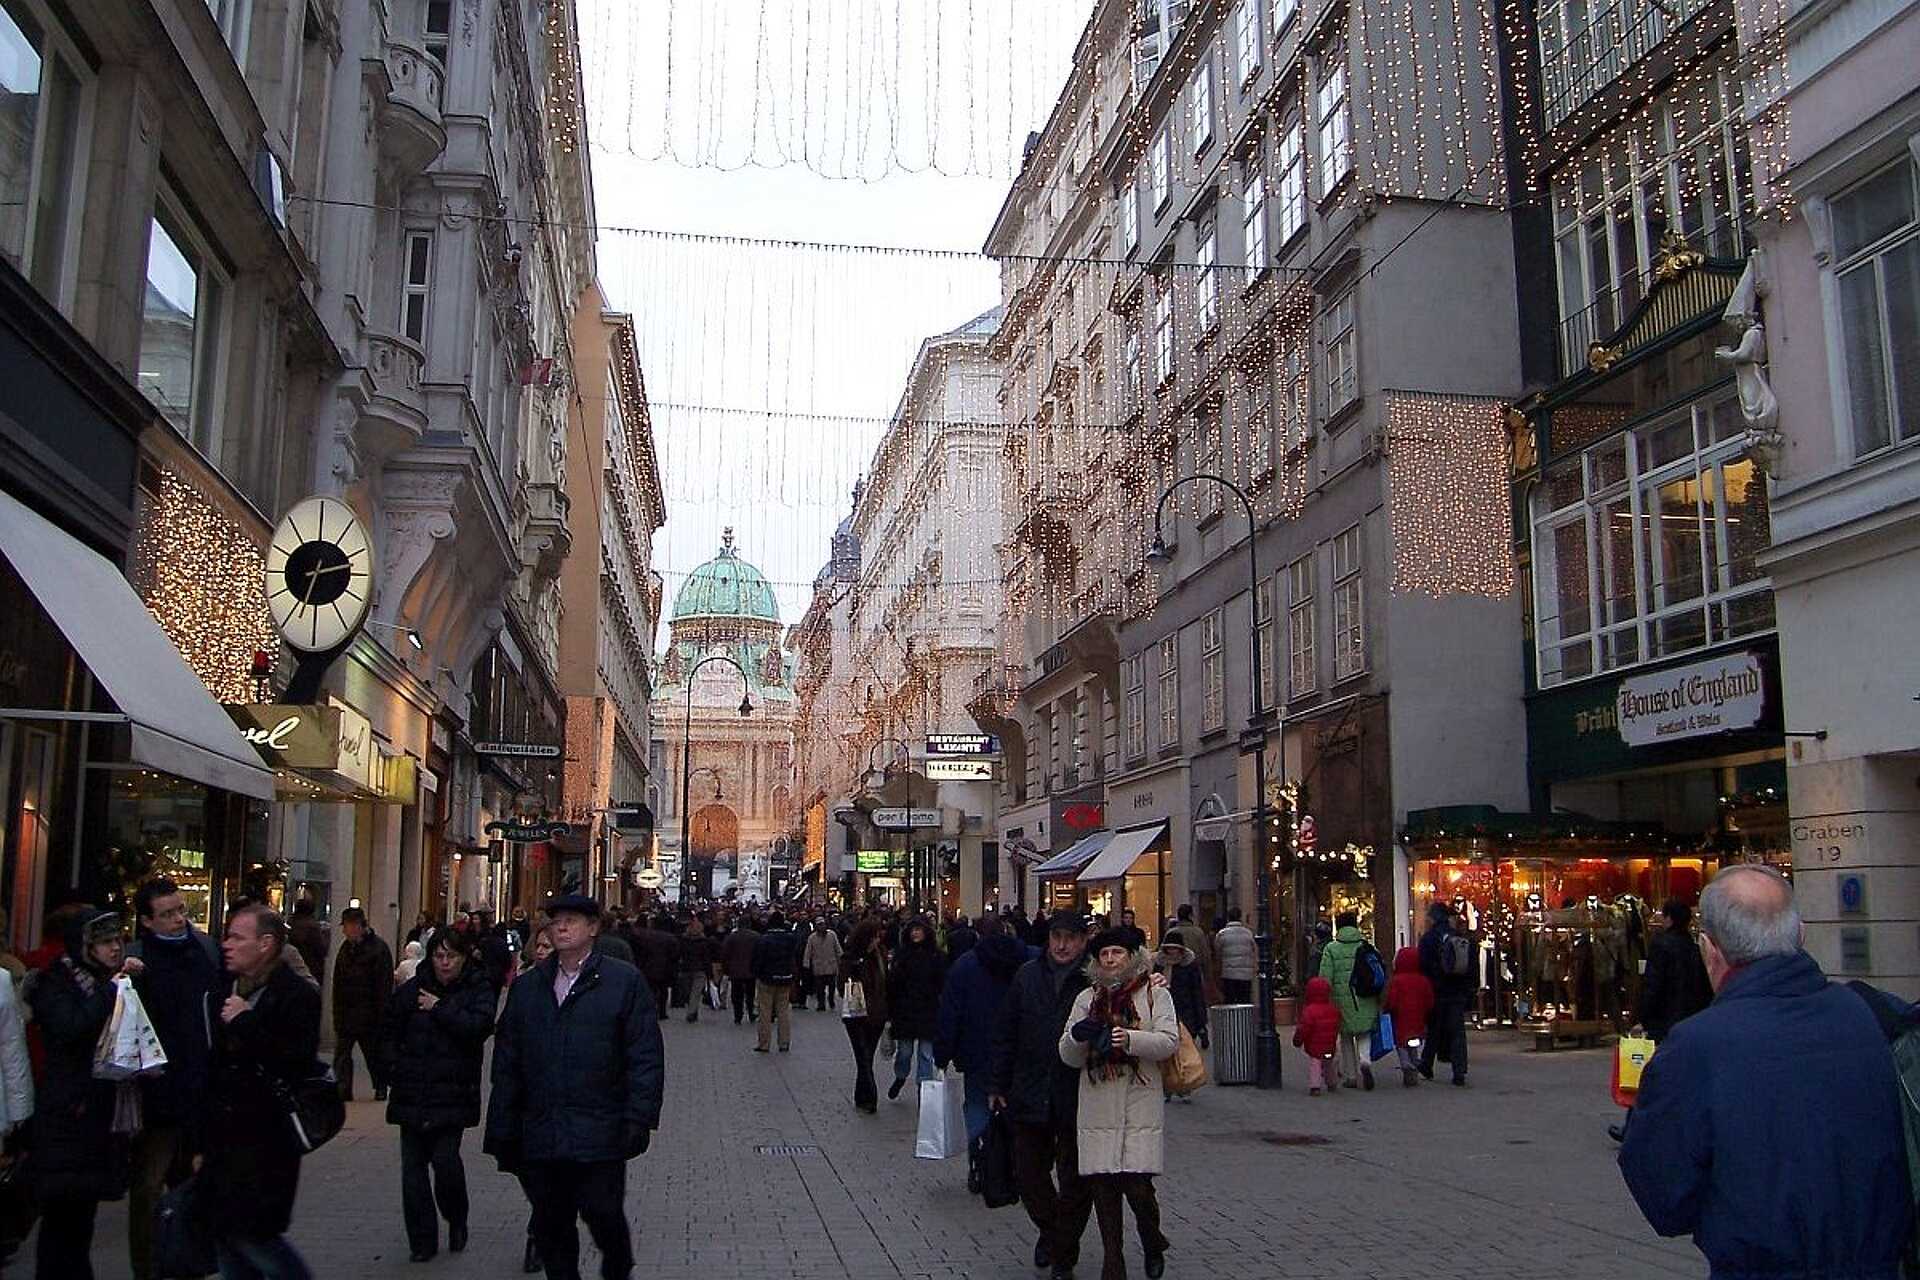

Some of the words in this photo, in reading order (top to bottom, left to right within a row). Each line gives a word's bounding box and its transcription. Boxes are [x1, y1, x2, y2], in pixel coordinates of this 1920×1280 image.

[1621, 688, 1669, 723] House
[1671, 679, 1686, 710] of
[1687, 666, 1759, 707] England
[1793, 823, 1865, 841] Graben
[1816, 845, 1841, 862] 19
